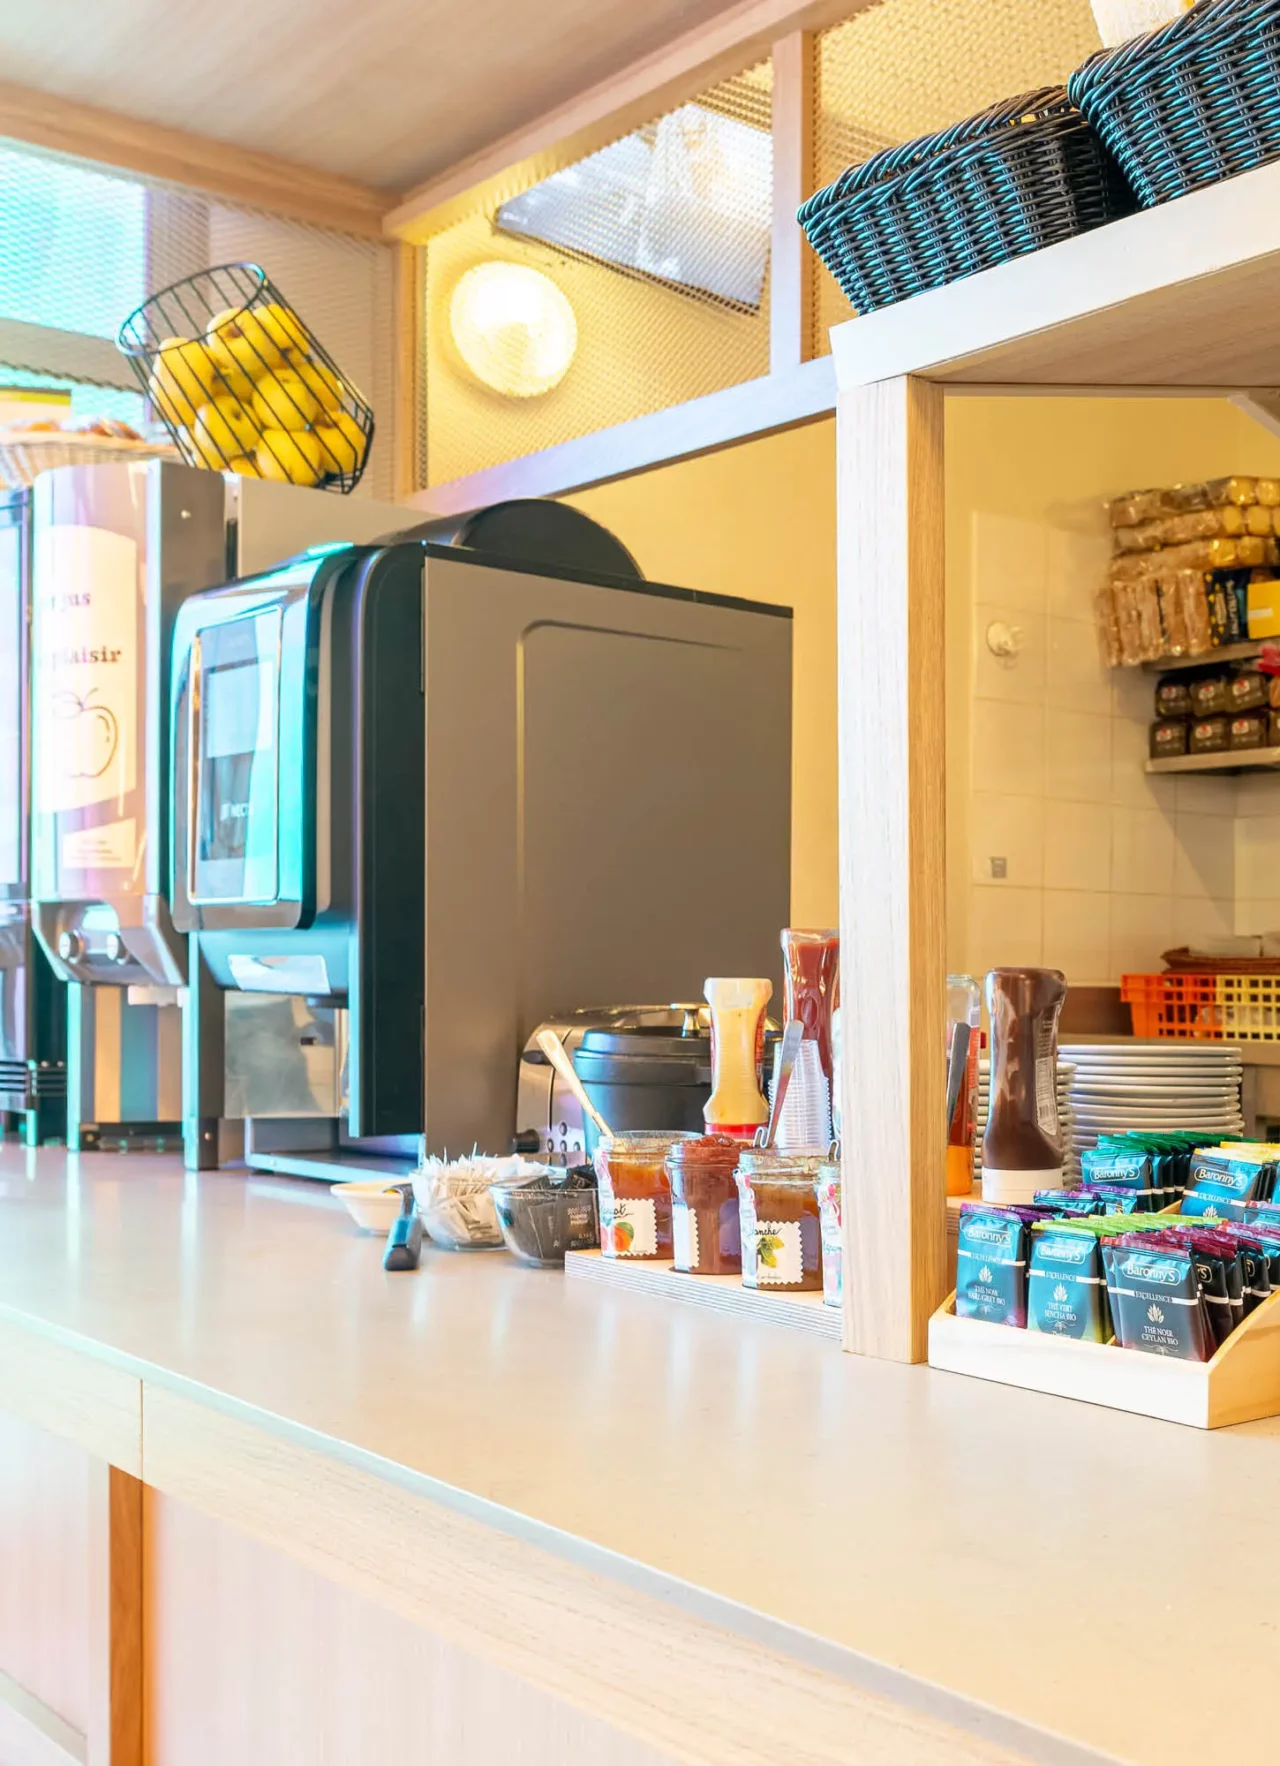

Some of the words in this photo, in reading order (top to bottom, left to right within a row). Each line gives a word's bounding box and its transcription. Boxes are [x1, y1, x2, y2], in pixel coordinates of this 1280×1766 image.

[1134, 1290, 1173, 1304] EXCELLENCE
[1141, 1333, 1167, 1344] CEYLAN
[1167, 1336, 1179, 1346] BIO
[1156, 1328, 1174, 1338] NOIR
